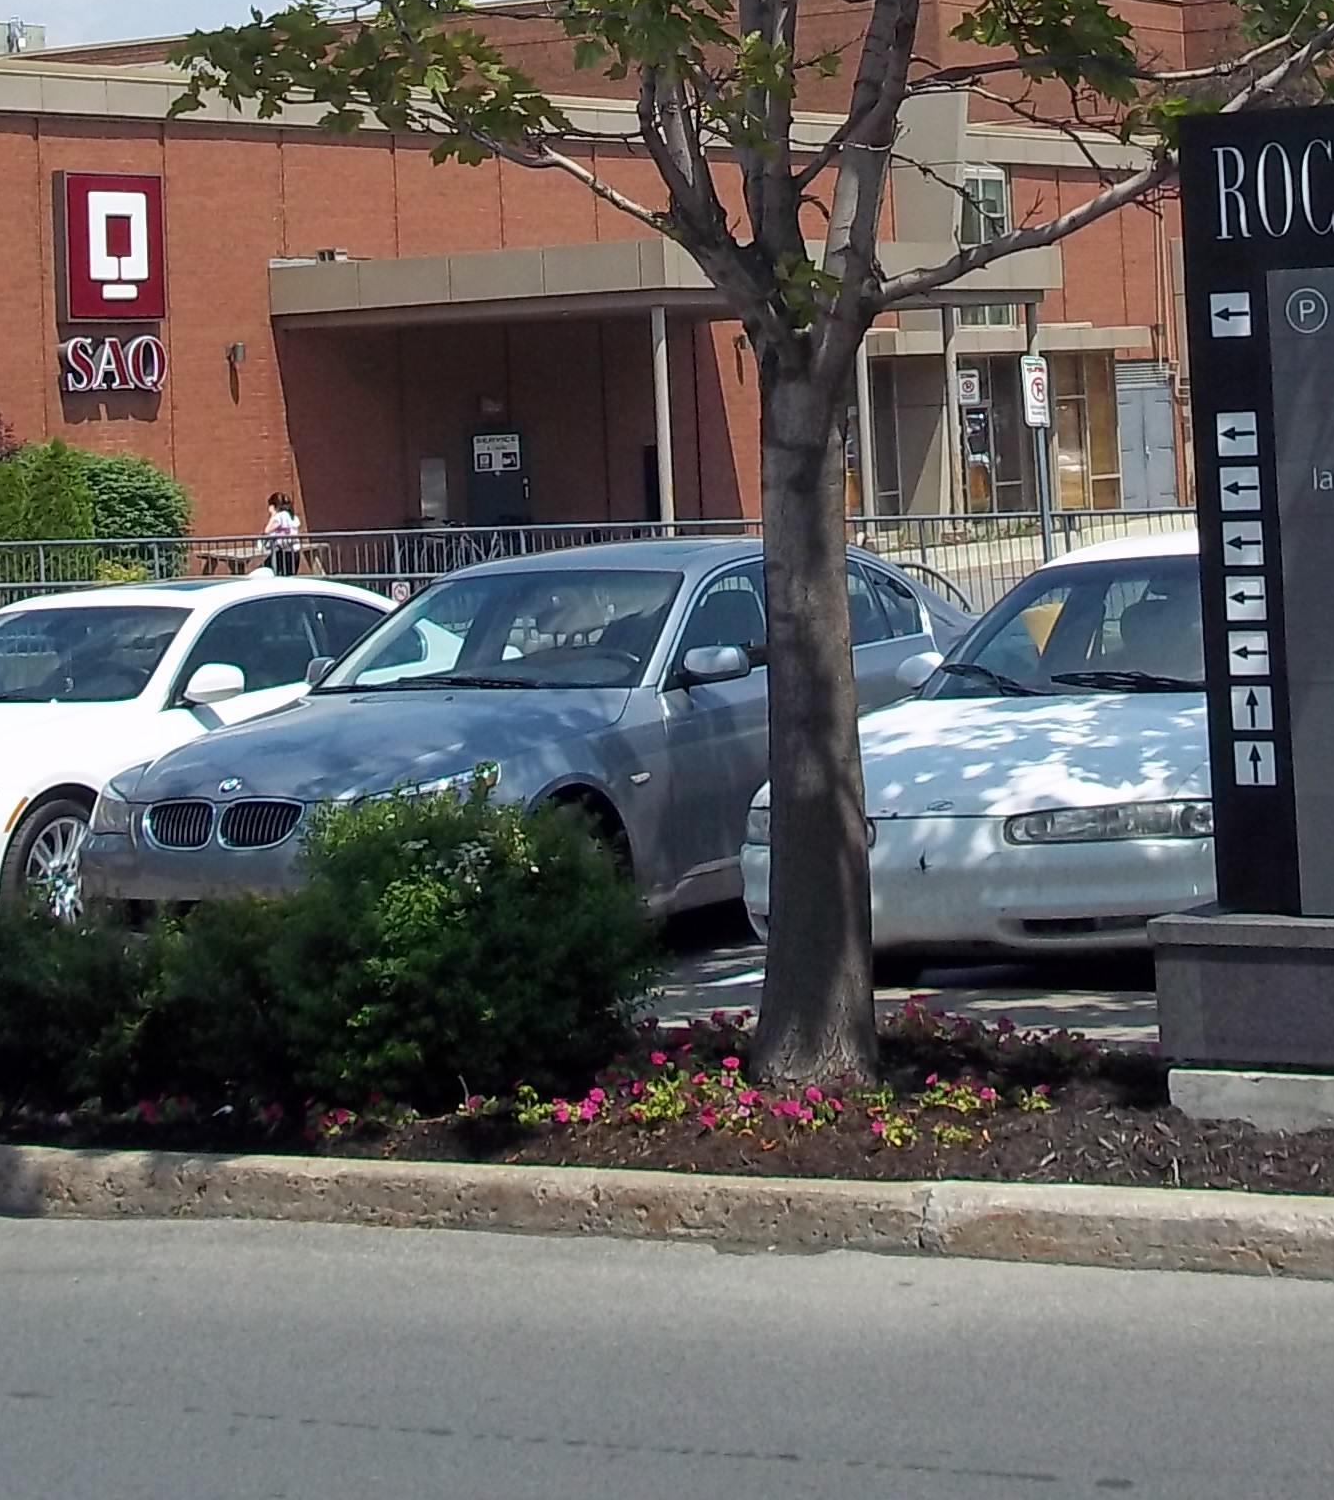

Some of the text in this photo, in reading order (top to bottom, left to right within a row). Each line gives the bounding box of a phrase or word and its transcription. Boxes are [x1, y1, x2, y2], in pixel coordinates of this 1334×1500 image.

[1298, 299, 1317, 323] P
[67, 335, 168, 393] SAQ
[1312, 467, 1334, 491] la
